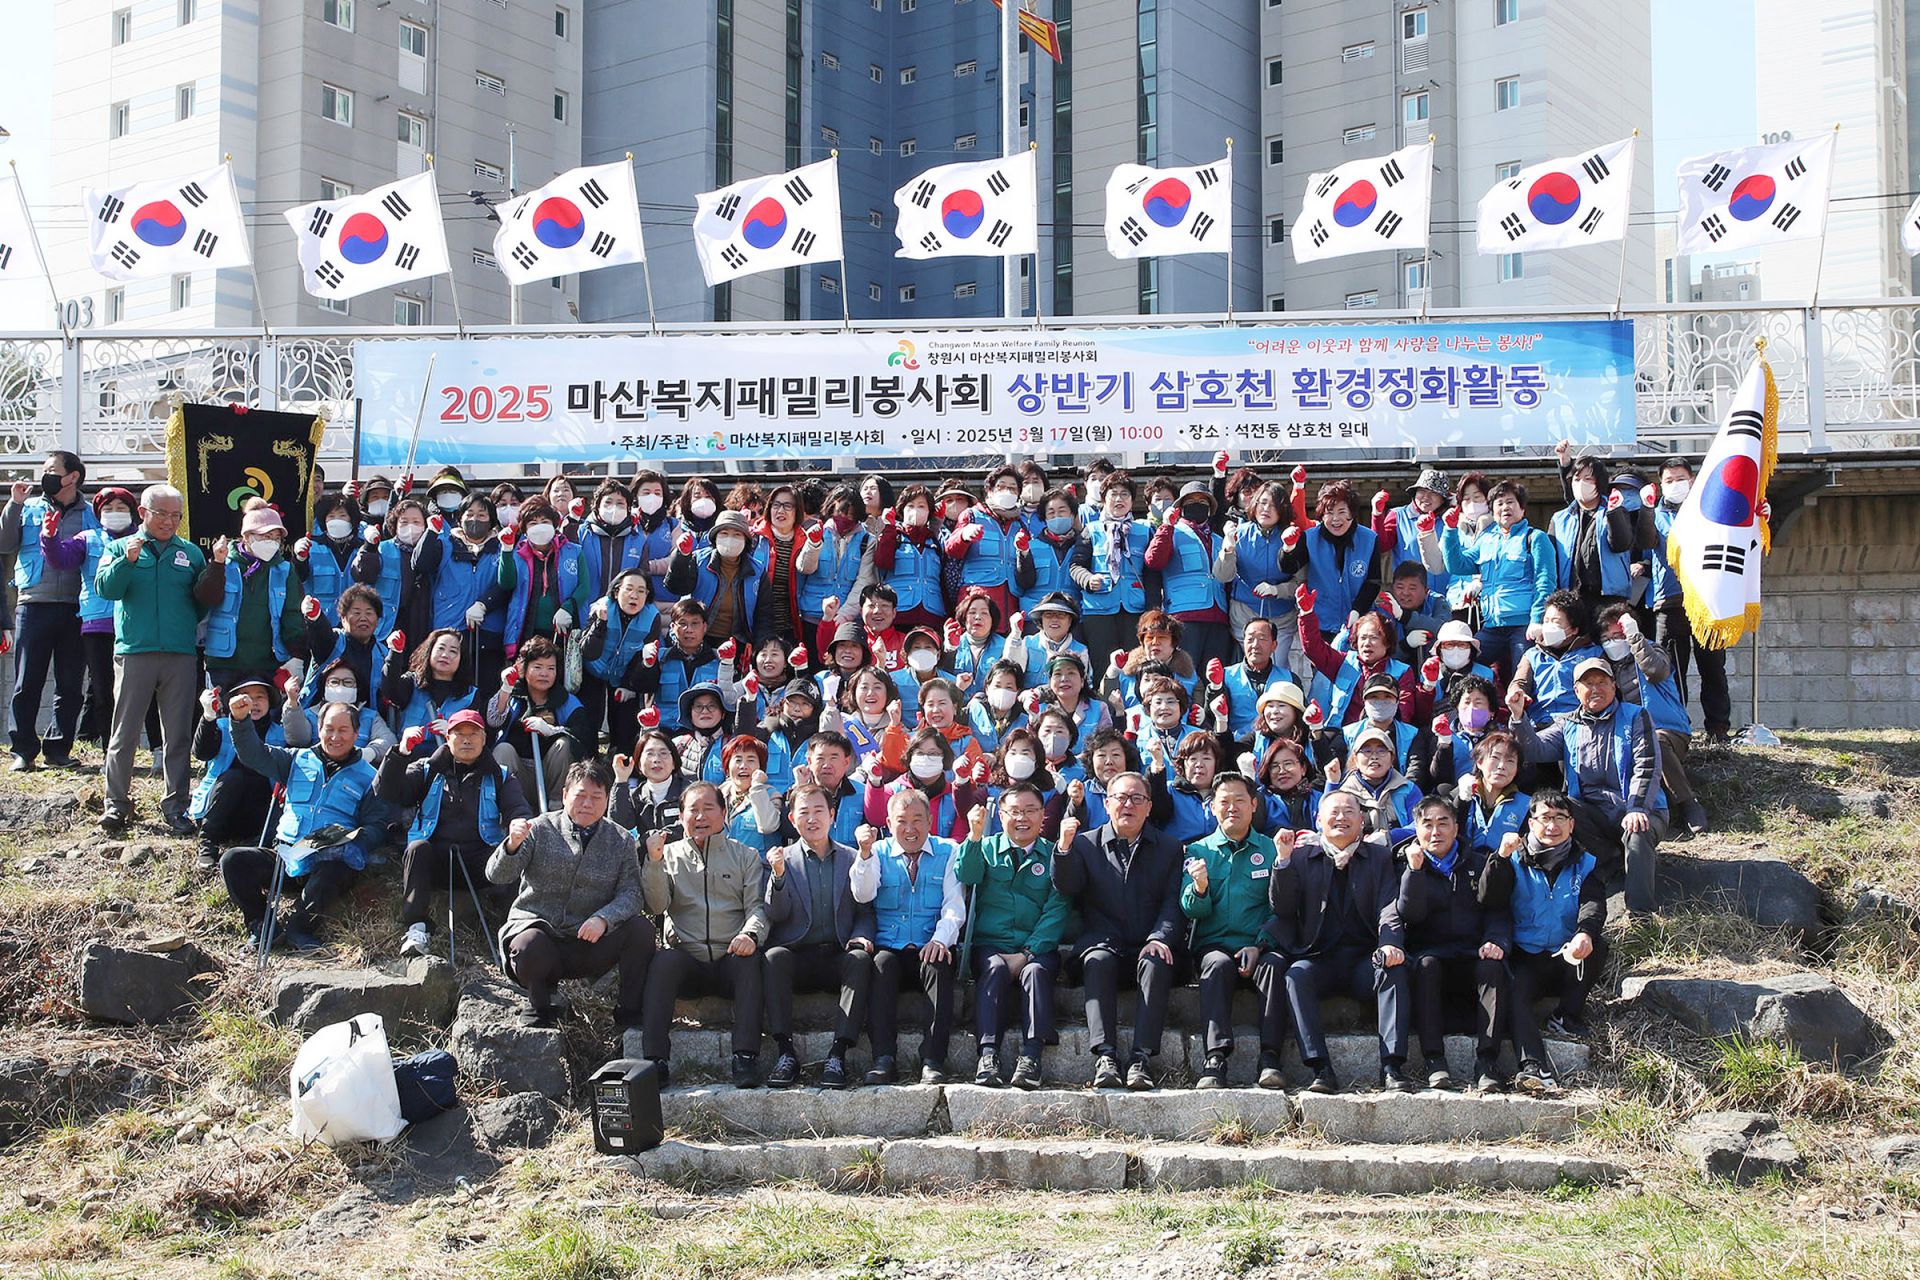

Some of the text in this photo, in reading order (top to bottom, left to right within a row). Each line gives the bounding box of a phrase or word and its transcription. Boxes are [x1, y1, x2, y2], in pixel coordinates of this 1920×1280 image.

[1761, 130, 1791, 145] 109
[55, 296, 93, 330] 103
[928, 339, 1096, 349] Changwon Masan Welfare Family Reunion
[1307, 338, 1353, 353] 이웃과
[1359, 338, 1389, 353] 함께
[1394, 336, 1439, 352] 사랑을
[1446, 335, 1491, 351] 나누는
[927, 350, 1098, 365] 창원시 마산복지패밀리봉사회
[440, 364, 1547, 422] 2025 마산복지패밀리봉사회 상반기 삼호천 환경정화활동
[730, 429, 884, 448] 마산복지패밀리봉사회
[911, 428, 941, 444] 일시
[956, 427, 1013, 443] 2025년
[1018, 426, 1044, 443] 3월
[1050, 425, 1113, 442] 17일(월)
[1119, 425, 1163, 440] 10:00
[1189, 424, 1220, 440] 장소
[1234, 423, 1280, 439] 석전동
[1286, 422, 1333, 438] 삼호천
[1338, 421, 1369, 438] 일대
